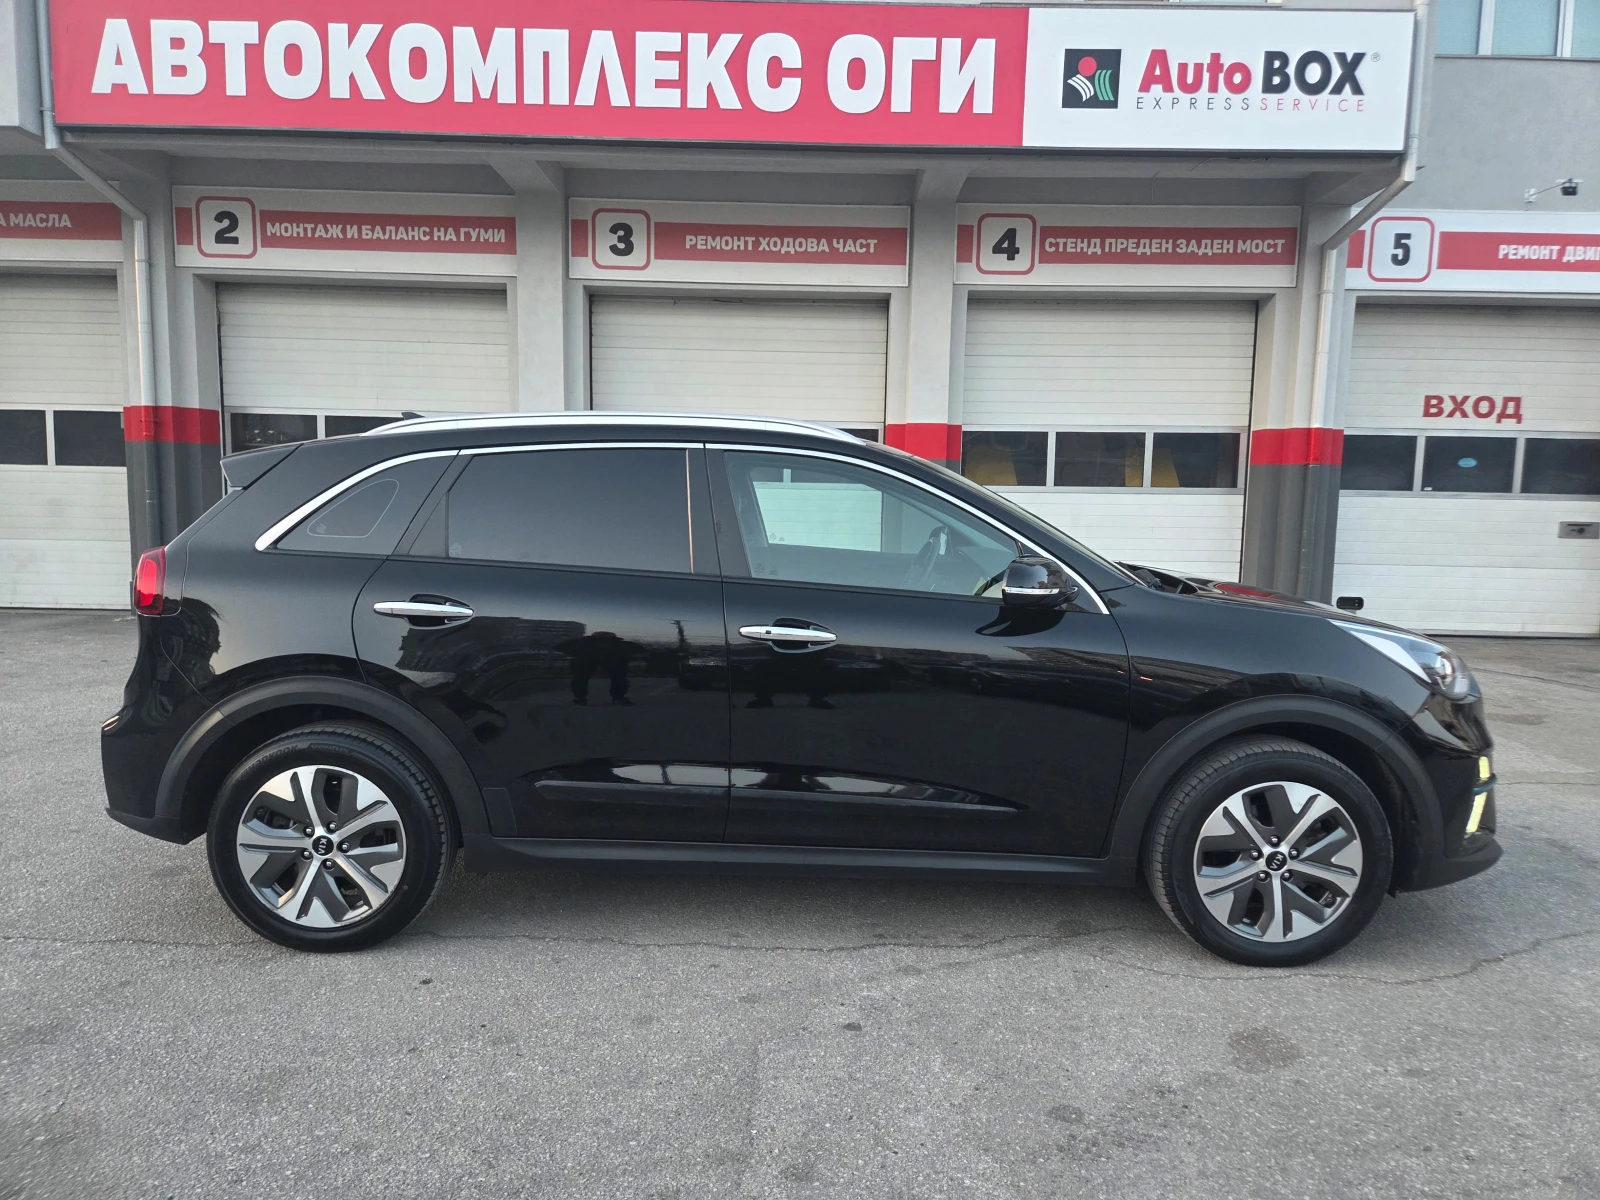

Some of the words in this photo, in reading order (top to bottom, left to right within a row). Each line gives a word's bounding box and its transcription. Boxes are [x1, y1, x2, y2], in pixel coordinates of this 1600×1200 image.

[91, 18, 803, 113] АВТОКОМПЛЕКС
[826, 33, 997, 115] ОГИ
[1138, 48, 1253, 95] Auto
[1261, 50, 1367, 97] BOX
[10, 213, 72, 228] МАСЛА
[213, 210, 240, 246] 2
[266, 222, 343, 239] МОНТАЖ
[346, 224, 358, 239] И
[361, 225, 431, 241] БАЛАНС
[433, 226, 458, 242] НА
[460, 227, 506, 242] ГУМИ
[608, 222, 635, 257] 3
[685, 234, 755, 251] РЕМОНТ
[758, 236, 830, 254] ХОДОВА
[832, 238, 878, 253] ЧАСТ
[991, 228, 1020, 261] 4
[1044, 237, 1102, 254] СТЕНД
[1104, 238, 1173, 256] ПРЕДЕН
[1176, 239, 1234, 256] ЗАДЕН
[1236, 239, 1286, 254] МОСТ
[1391, 233, 1412, 266] 5
[1498, 244, 1561, 260] РЕМОНТ
[1422, 394, 1523, 424] ВХОД
[317, 838, 328, 854] KIA
[1269, 853, 1284, 869] KIA
